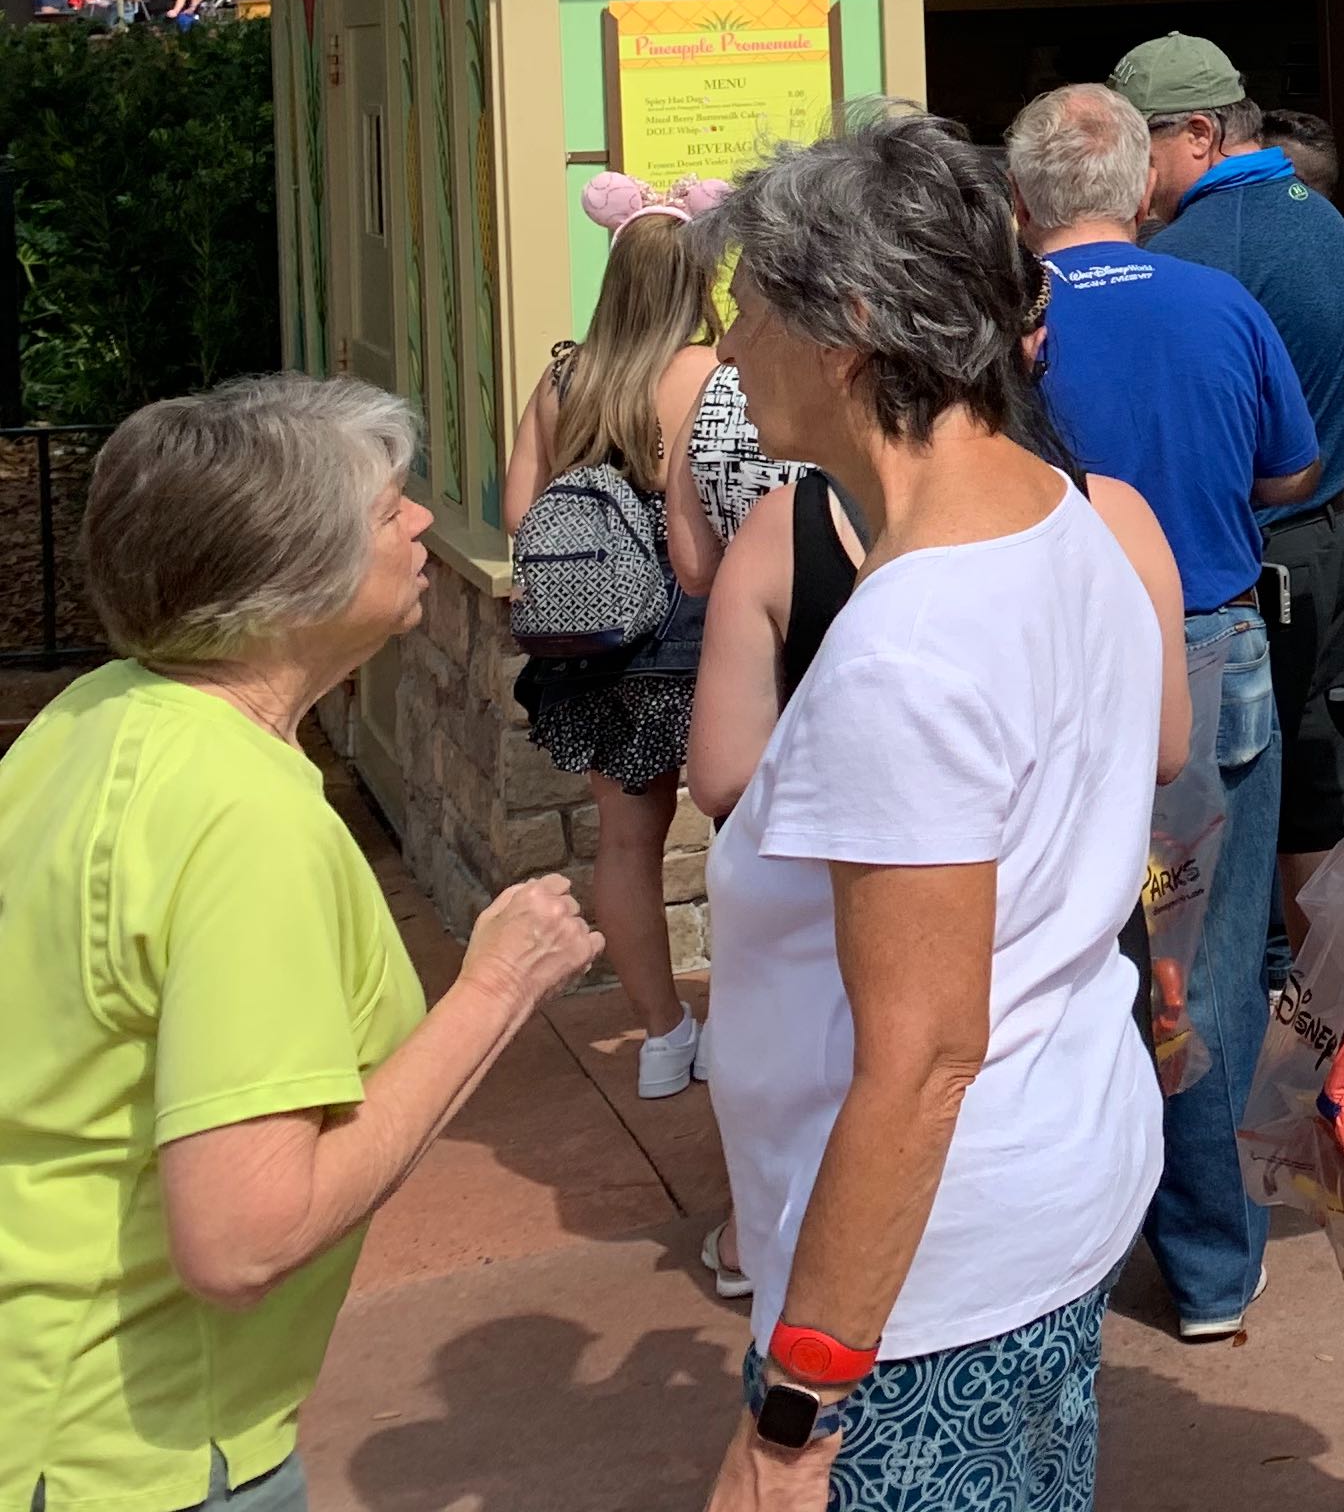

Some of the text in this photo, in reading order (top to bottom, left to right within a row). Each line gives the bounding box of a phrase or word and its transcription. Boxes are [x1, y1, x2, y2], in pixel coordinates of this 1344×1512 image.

[635, 33, 812, 60] Pineapple Promenade
[703, 78, 747, 90] MENU
[687, 141, 757, 155] BEVERAG
